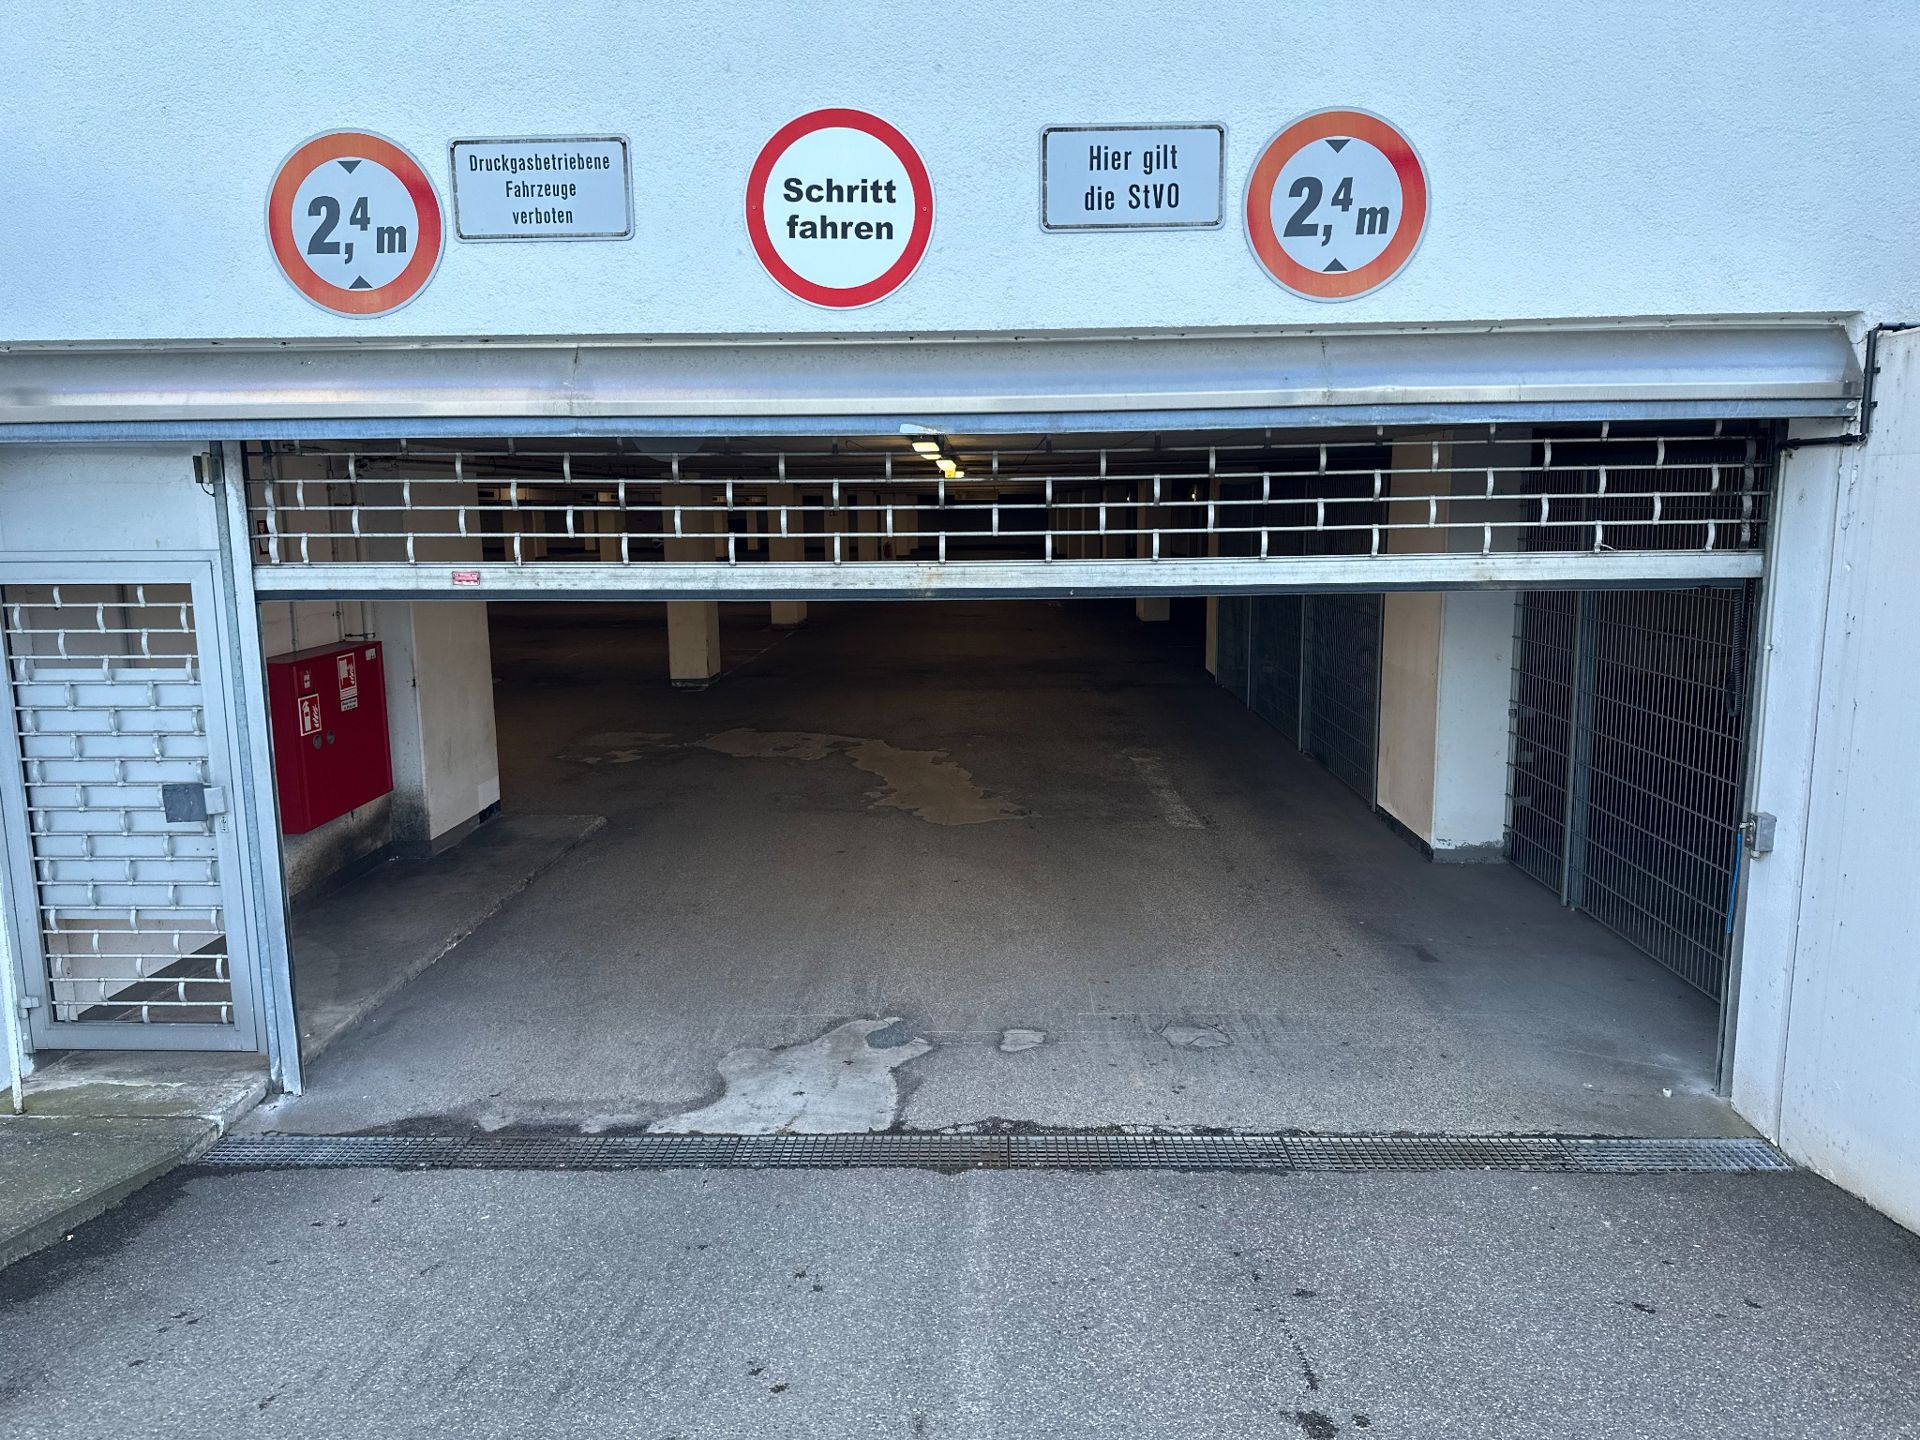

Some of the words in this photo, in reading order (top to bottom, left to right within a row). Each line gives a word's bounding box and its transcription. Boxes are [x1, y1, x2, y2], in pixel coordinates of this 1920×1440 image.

[469, 152, 611, 175] Druckgasbetriebene
[1089, 145, 1132, 171] Hier
[1143, 144, 1178, 175] gilt
[505, 180, 577, 200] Fahrzeuge
[783, 177, 897, 204] Schritt
[1084, 185, 1115, 211] die
[1128, 183, 1180, 209] StVO
[512, 207, 573, 225] verboten
[786, 214, 894, 240] fahren
